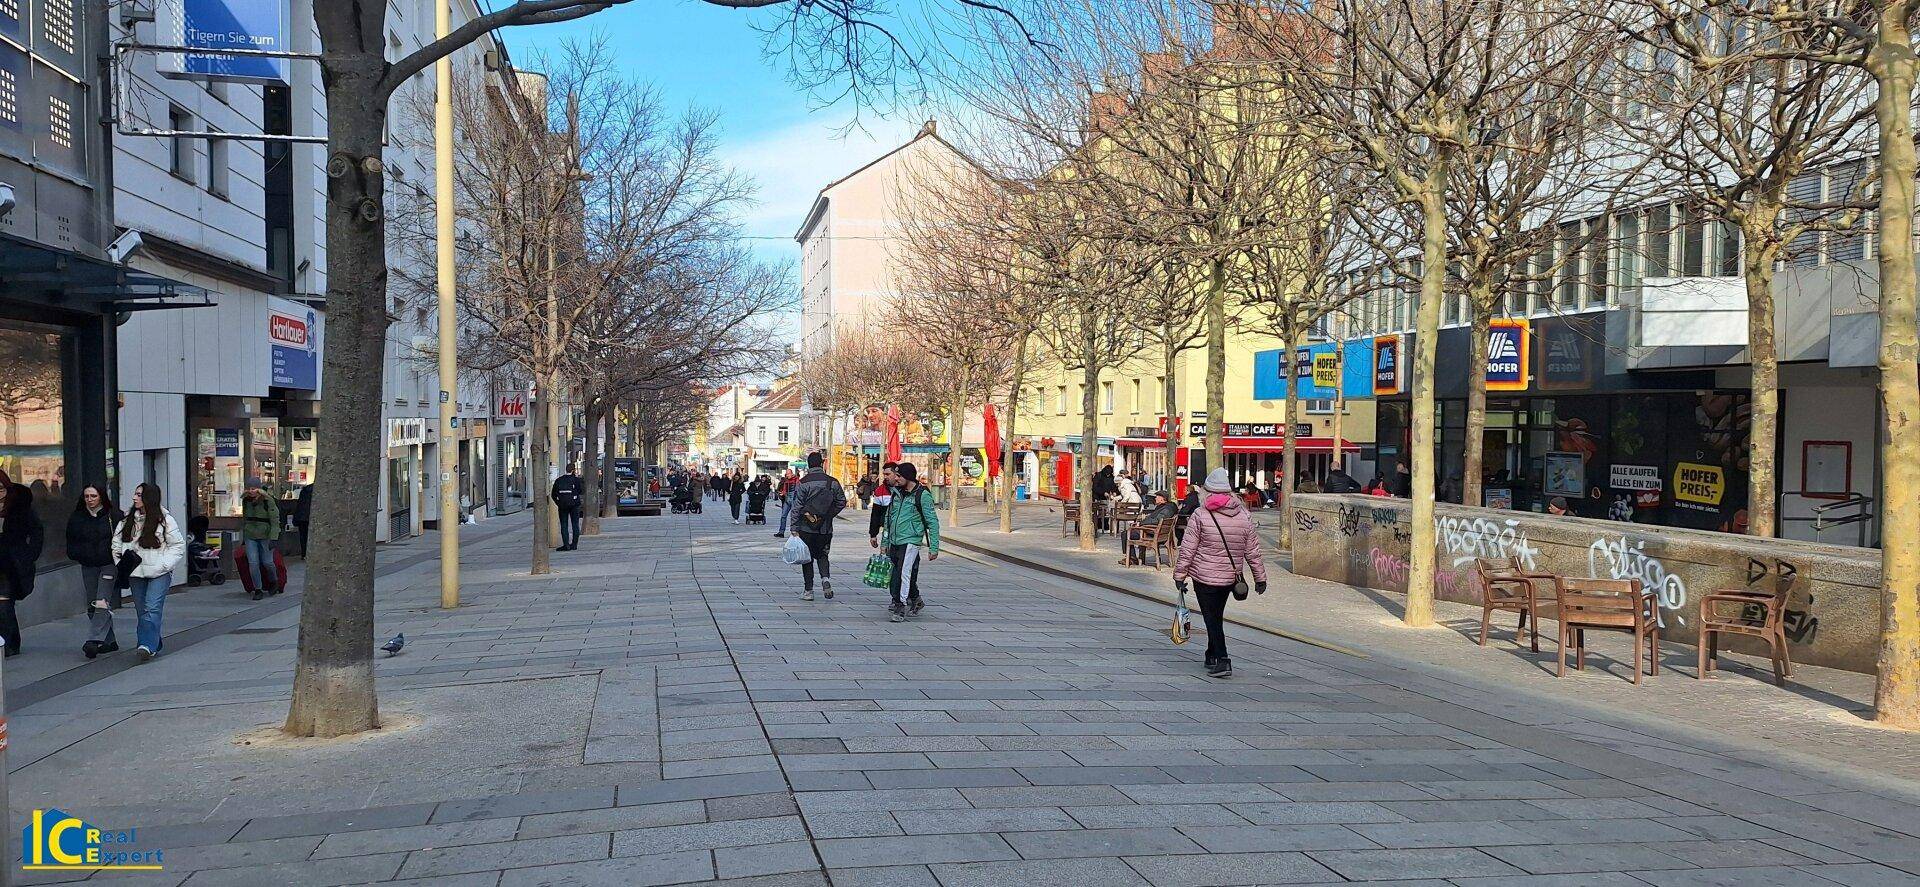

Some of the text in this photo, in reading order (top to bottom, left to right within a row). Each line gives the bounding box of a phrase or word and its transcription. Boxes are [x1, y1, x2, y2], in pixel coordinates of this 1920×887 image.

[188, 27, 274, 46] Tigern Sie zum
[273, 316, 304, 343] Hartlauer
[1316, 357, 1337, 370] HOFER
[1301, 365, 1313, 376] ZUM
[1377, 371, 1395, 381] HOFER
[500, 393, 524, 416] kik
[1253, 424, 1276, 434] CAFÉ
[1612, 466, 1656, 478] ALLE KAUFEN
[1681, 468, 1719, 484] HOFER
[1611, 479, 1662, 490] ALLES EIN ZUM
[1680, 482, 1717, 500] PREIS,-
